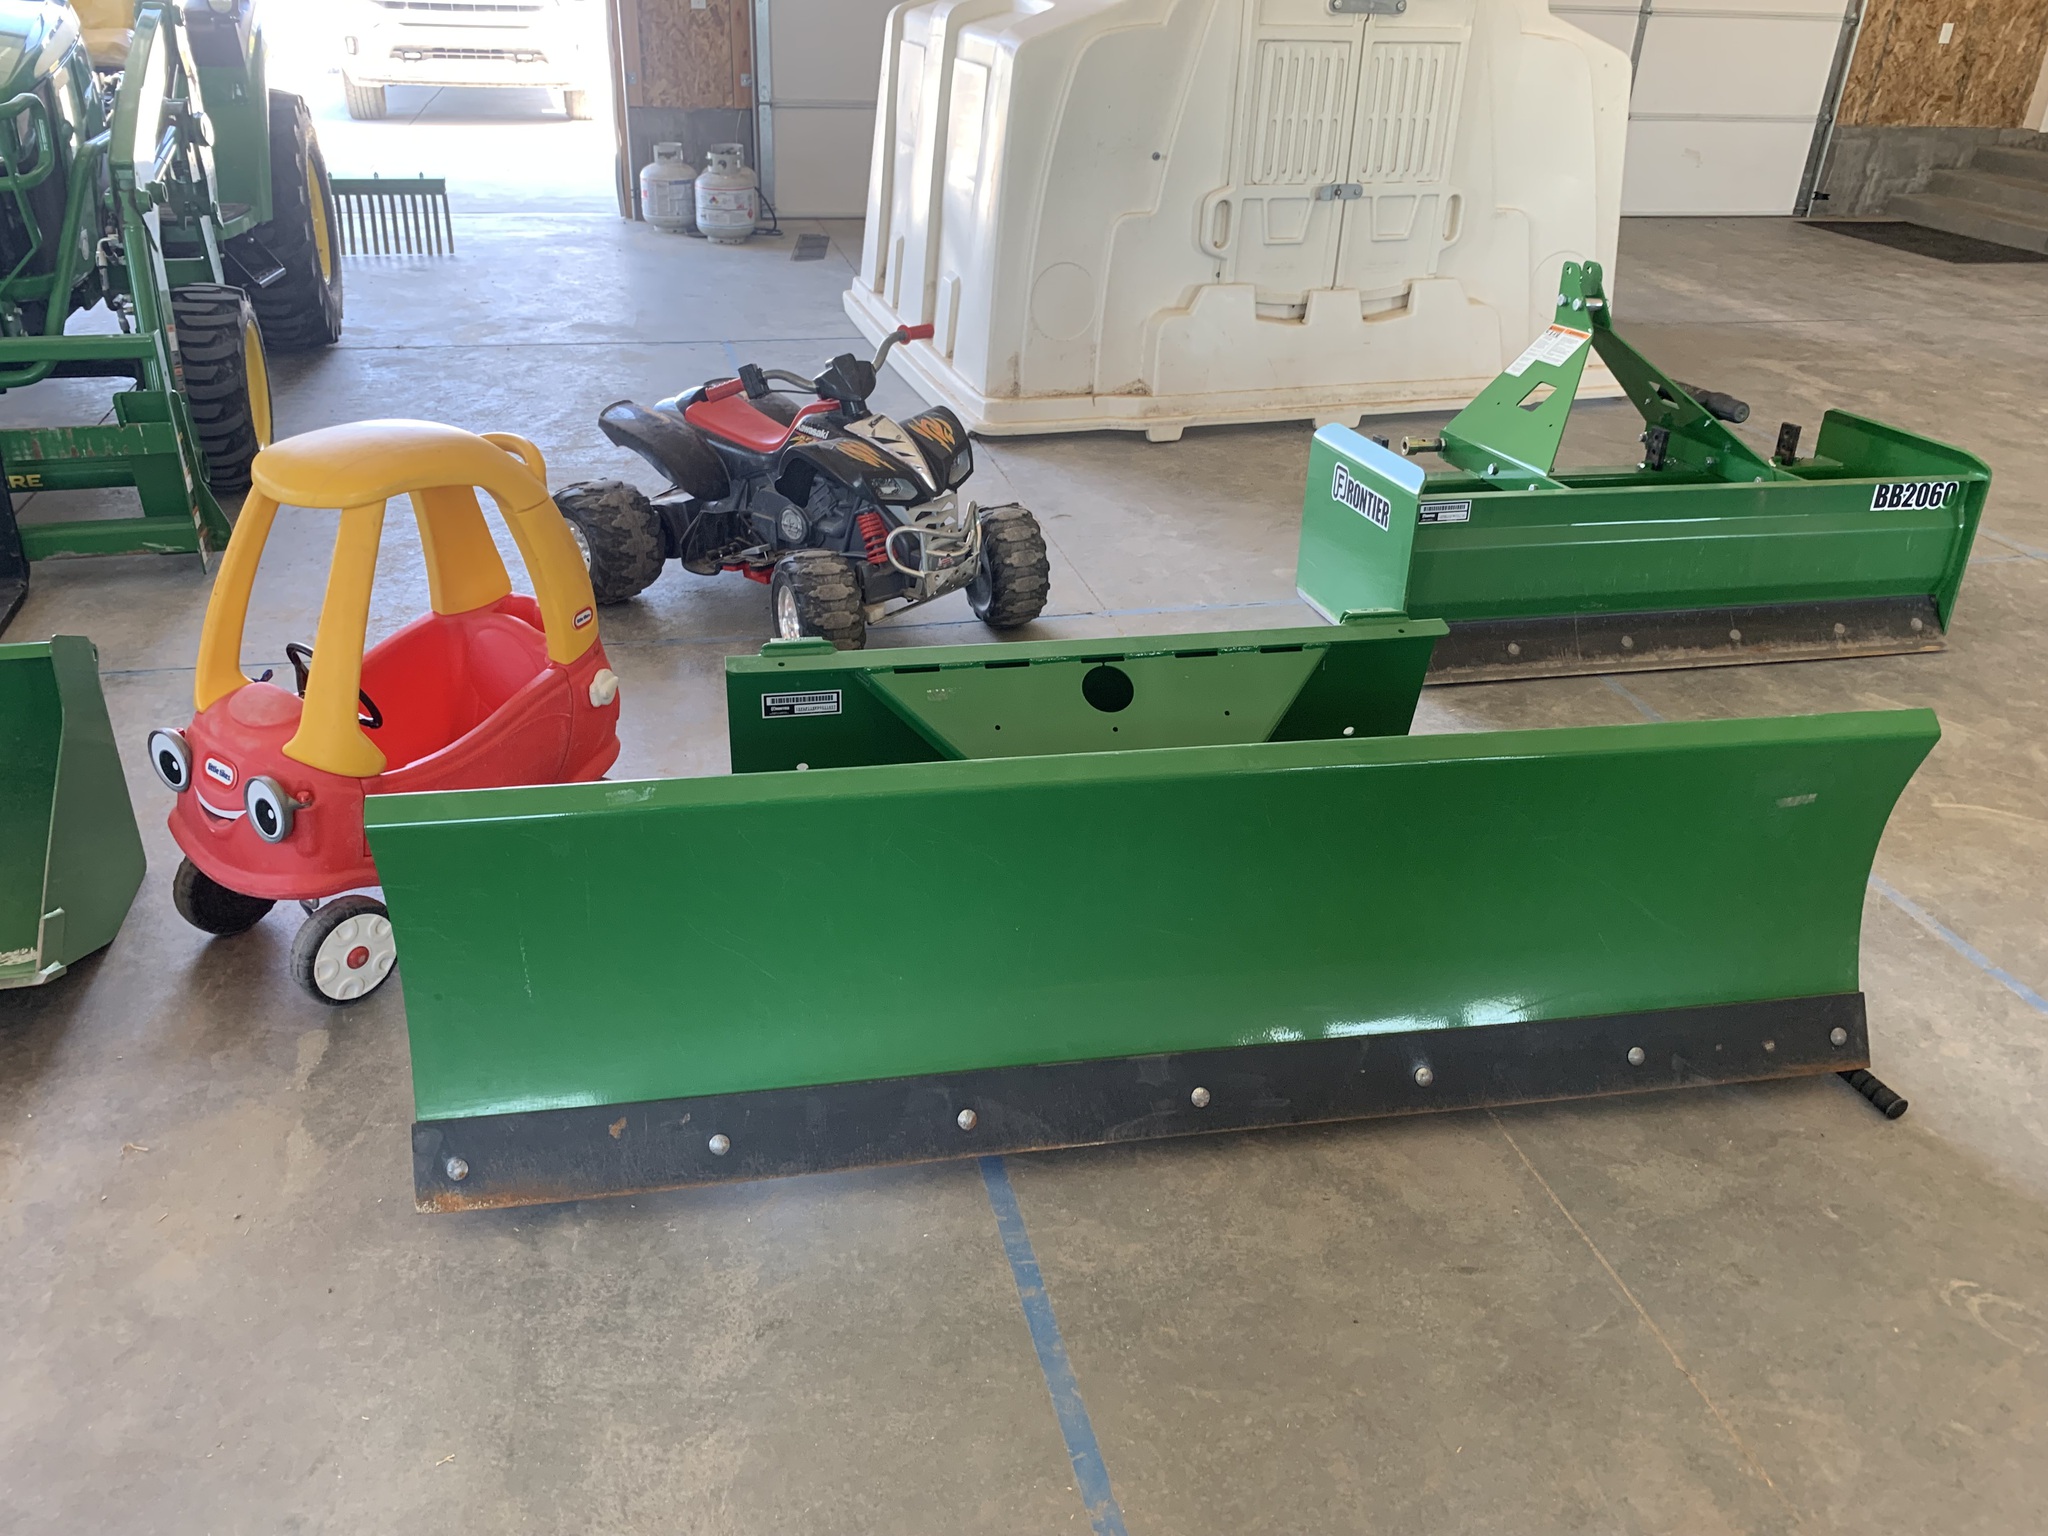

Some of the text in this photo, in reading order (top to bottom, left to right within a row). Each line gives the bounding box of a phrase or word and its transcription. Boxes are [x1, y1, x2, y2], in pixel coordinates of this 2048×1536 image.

[795, 423, 831, 440] Kawasaki
[1333, 464, 1390, 529] FRONTIER
[1873, 482, 1958, 509] BB2060
[207, 762, 219, 775] little
